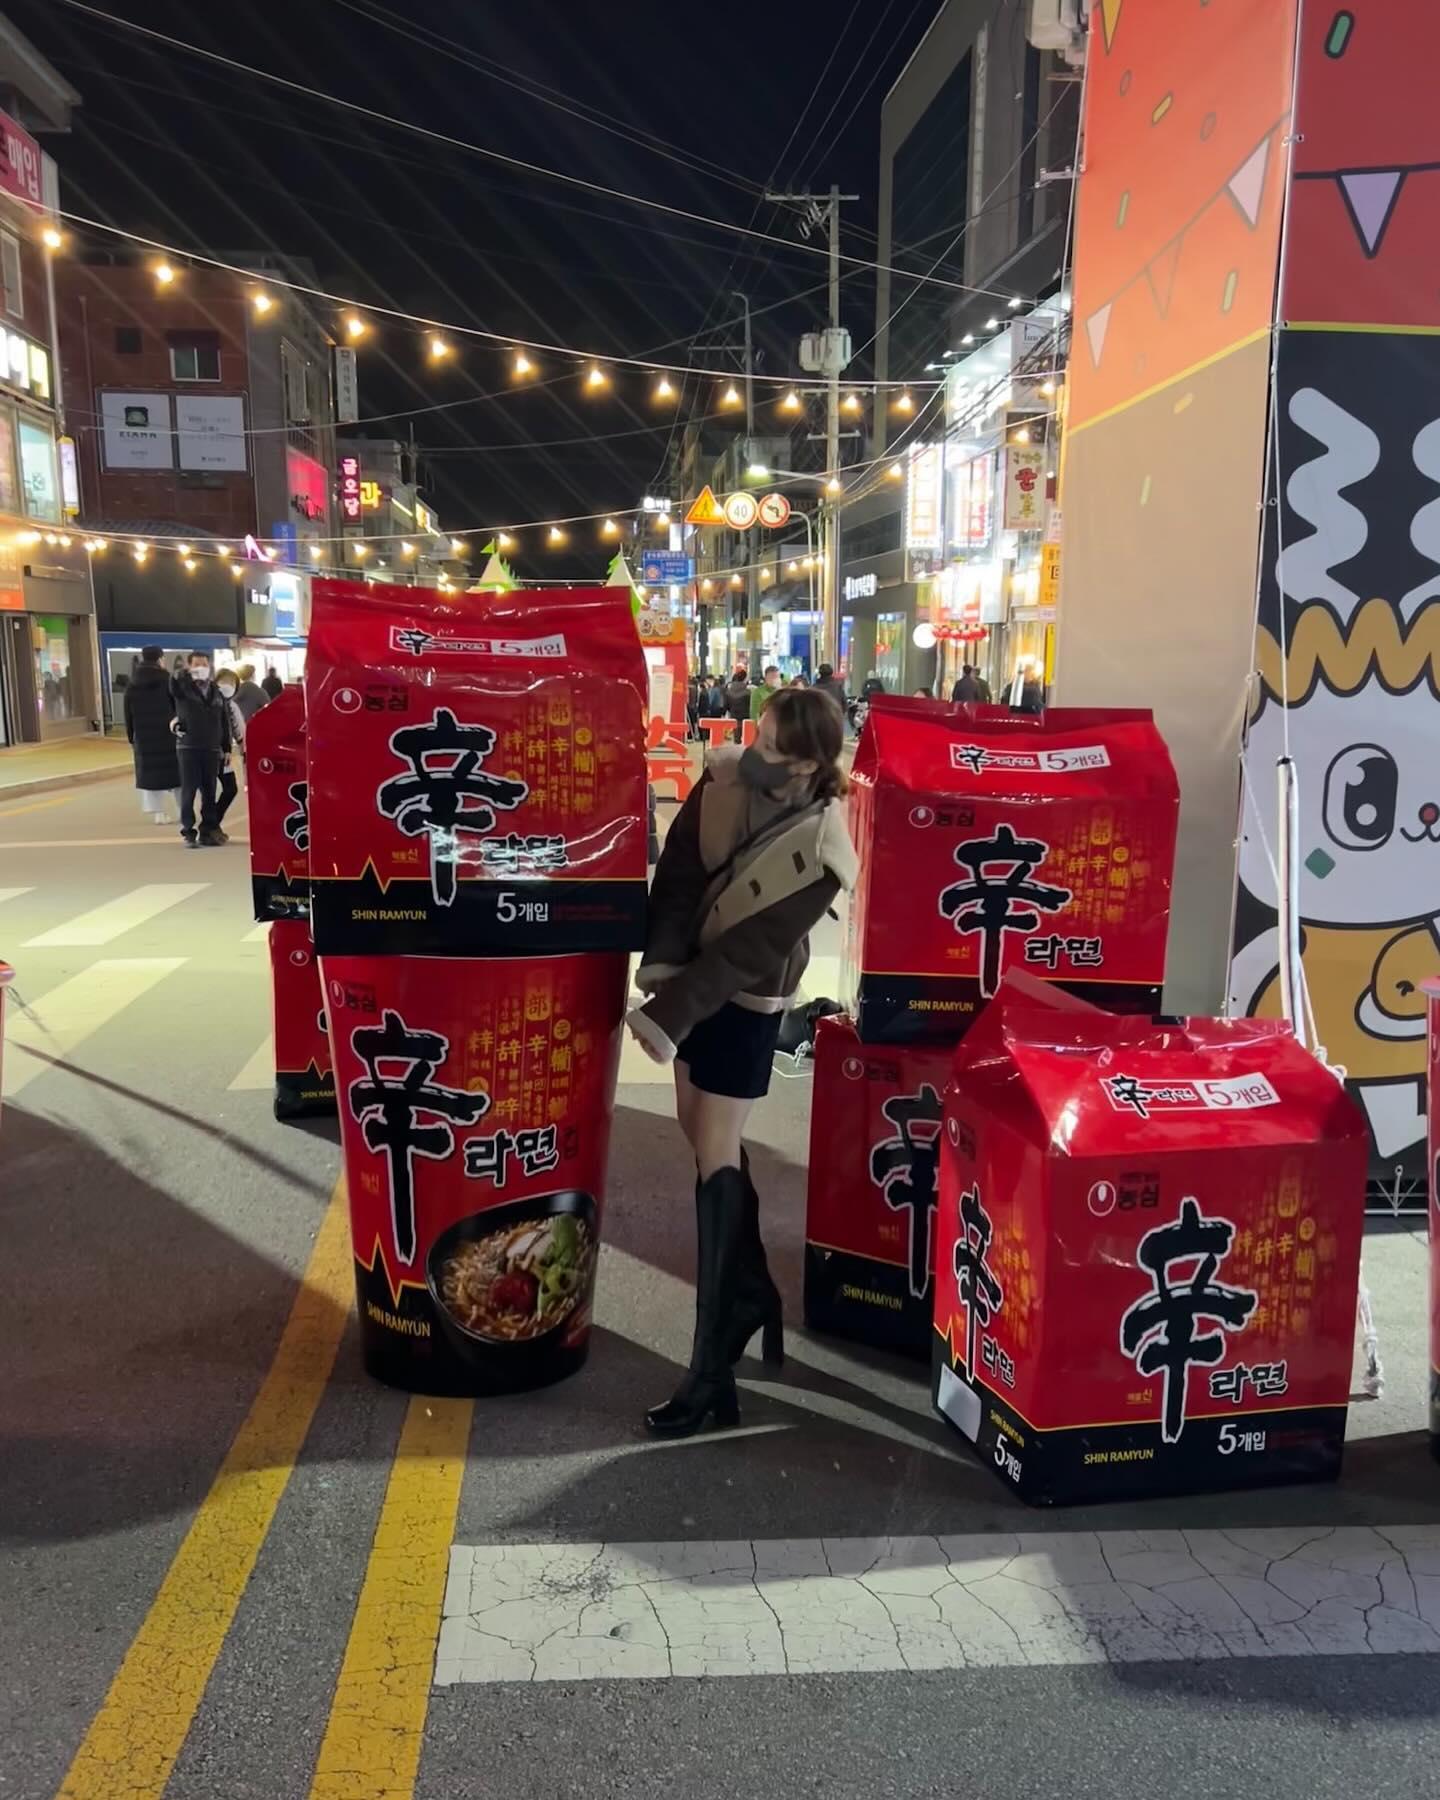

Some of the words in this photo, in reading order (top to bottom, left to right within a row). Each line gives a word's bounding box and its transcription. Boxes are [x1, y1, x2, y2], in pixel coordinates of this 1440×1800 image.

[733, 505, 748, 519] 40
[958, 745, 996, 774] 辛
[1045, 751, 1106, 770] 5개입
[377, 706, 529, 907] 辛
[352, 909, 378, 920] SHIN
[379, 909, 427, 921] RAMYUN
[496, 892, 549, 922] 5개입
[938, 823, 1073, 999] 辛
[1024, 934, 1104, 969] 라면
[908, 1000, 931, 1011] SHIN
[933, 1001, 974, 1013] RAMYUN
[1111, 1073, 1152, 1118] 辛
[1153, 1087, 1198, 1103] 라면
[1203, 1083, 1273, 1107] 5개입
[348, 1008, 490, 1266] 辛
[462, 1124, 560, 1188] 라면
[953, 1181, 1003, 1384] 辛
[981, 1334, 1016, 1389] 라면
[385, 1311, 431, 1337] RAMYUN
[1120, 1196, 1258, 1444] 辛
[1208, 1360, 1288, 1404] 라면
[1217, 1424, 1267, 1456] 5개입
[993, 1433, 1023, 1483] 5개입
[1084, 1451, 1108, 1465] SHIN
[1109, 1449, 1154, 1464] RAMYUN
